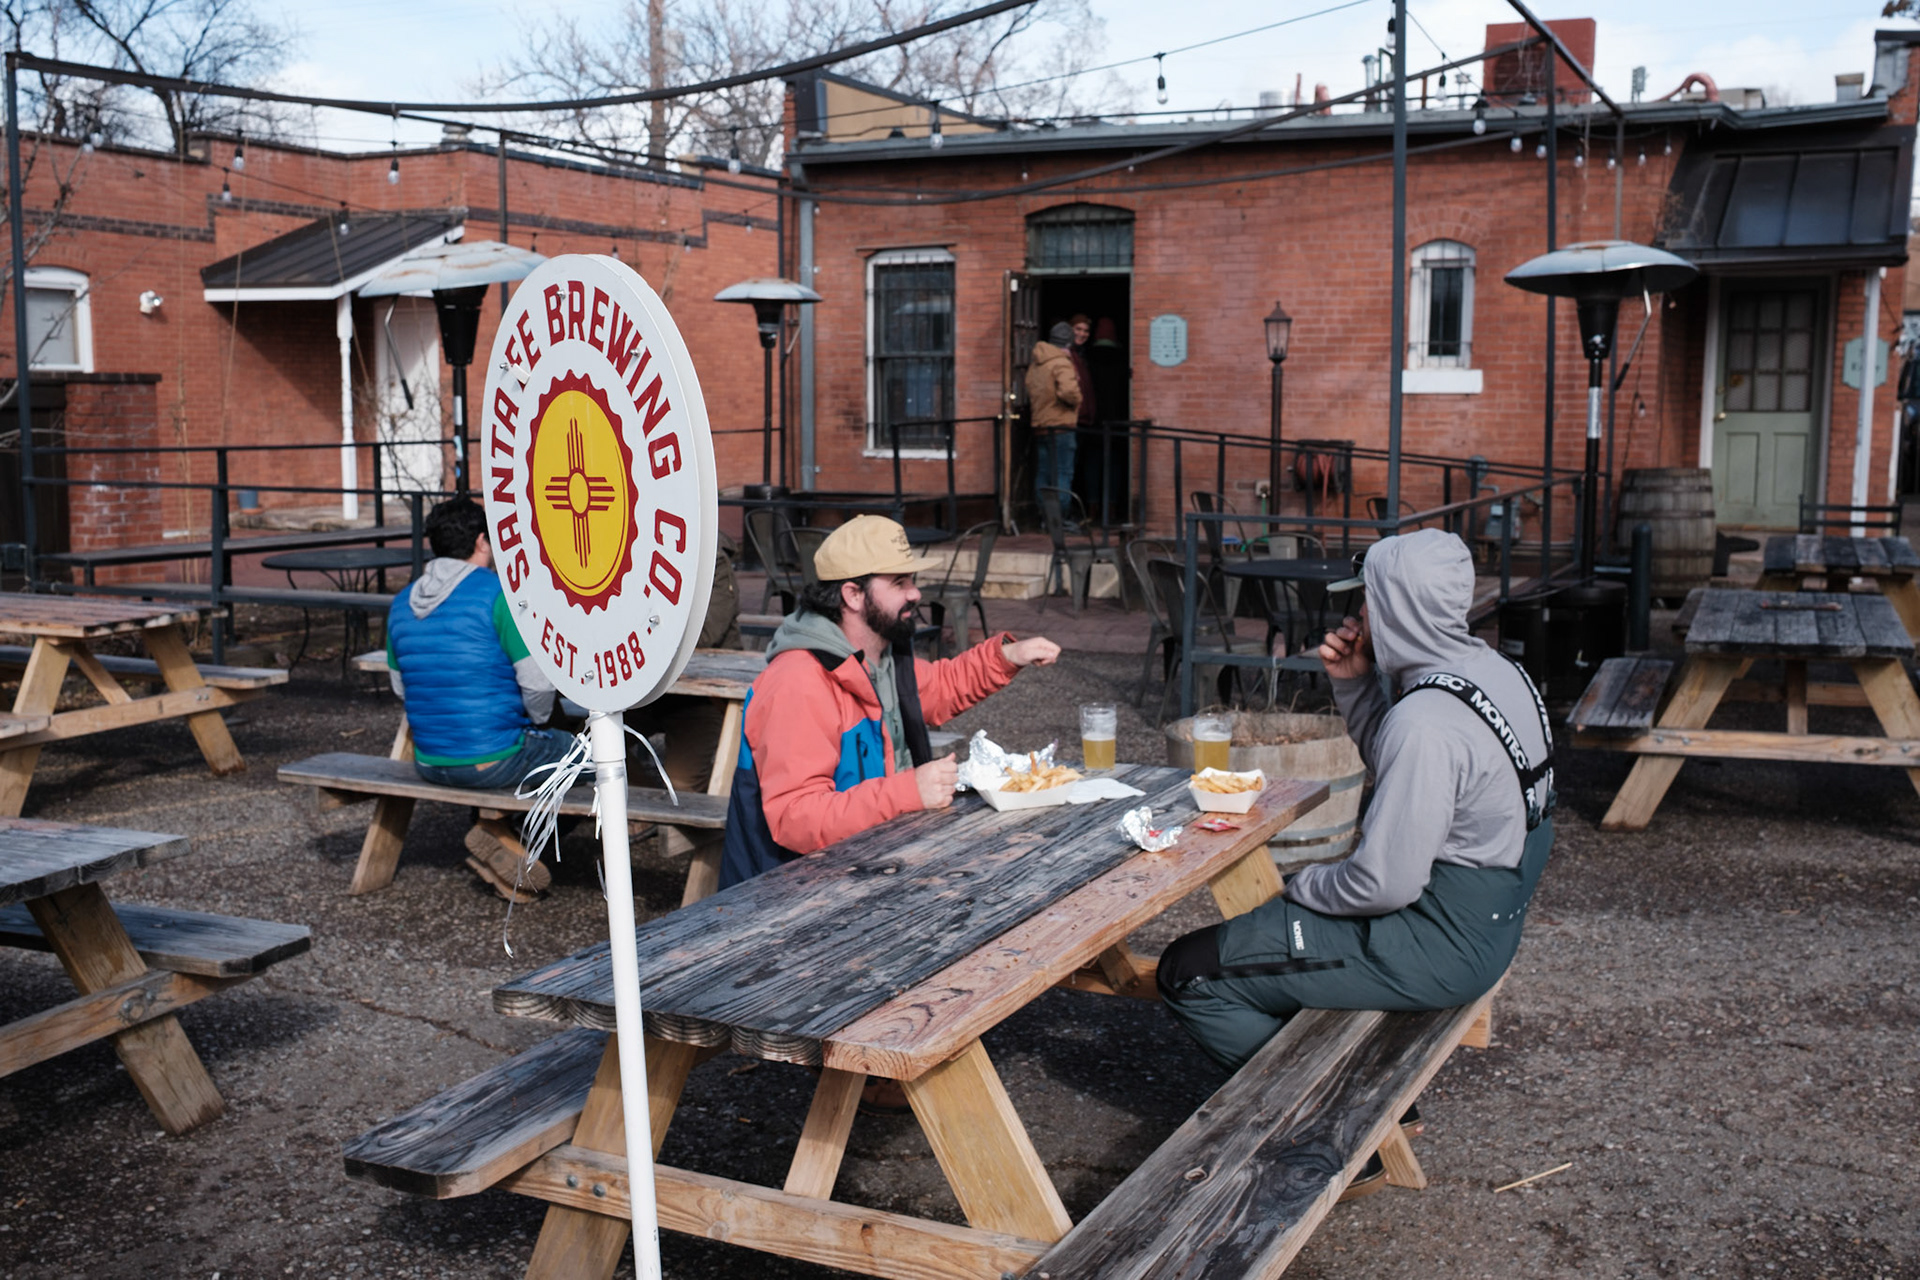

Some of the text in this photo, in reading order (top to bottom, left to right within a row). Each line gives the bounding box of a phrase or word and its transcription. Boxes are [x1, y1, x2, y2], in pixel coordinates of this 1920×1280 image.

[491, 280, 687, 606] SANTA FE BREWING CO.
[540, 617, 646, 689] EST. 1988
[1411, 673, 1467, 691] NTEC
[1470, 690, 1528, 769] MONTEC
